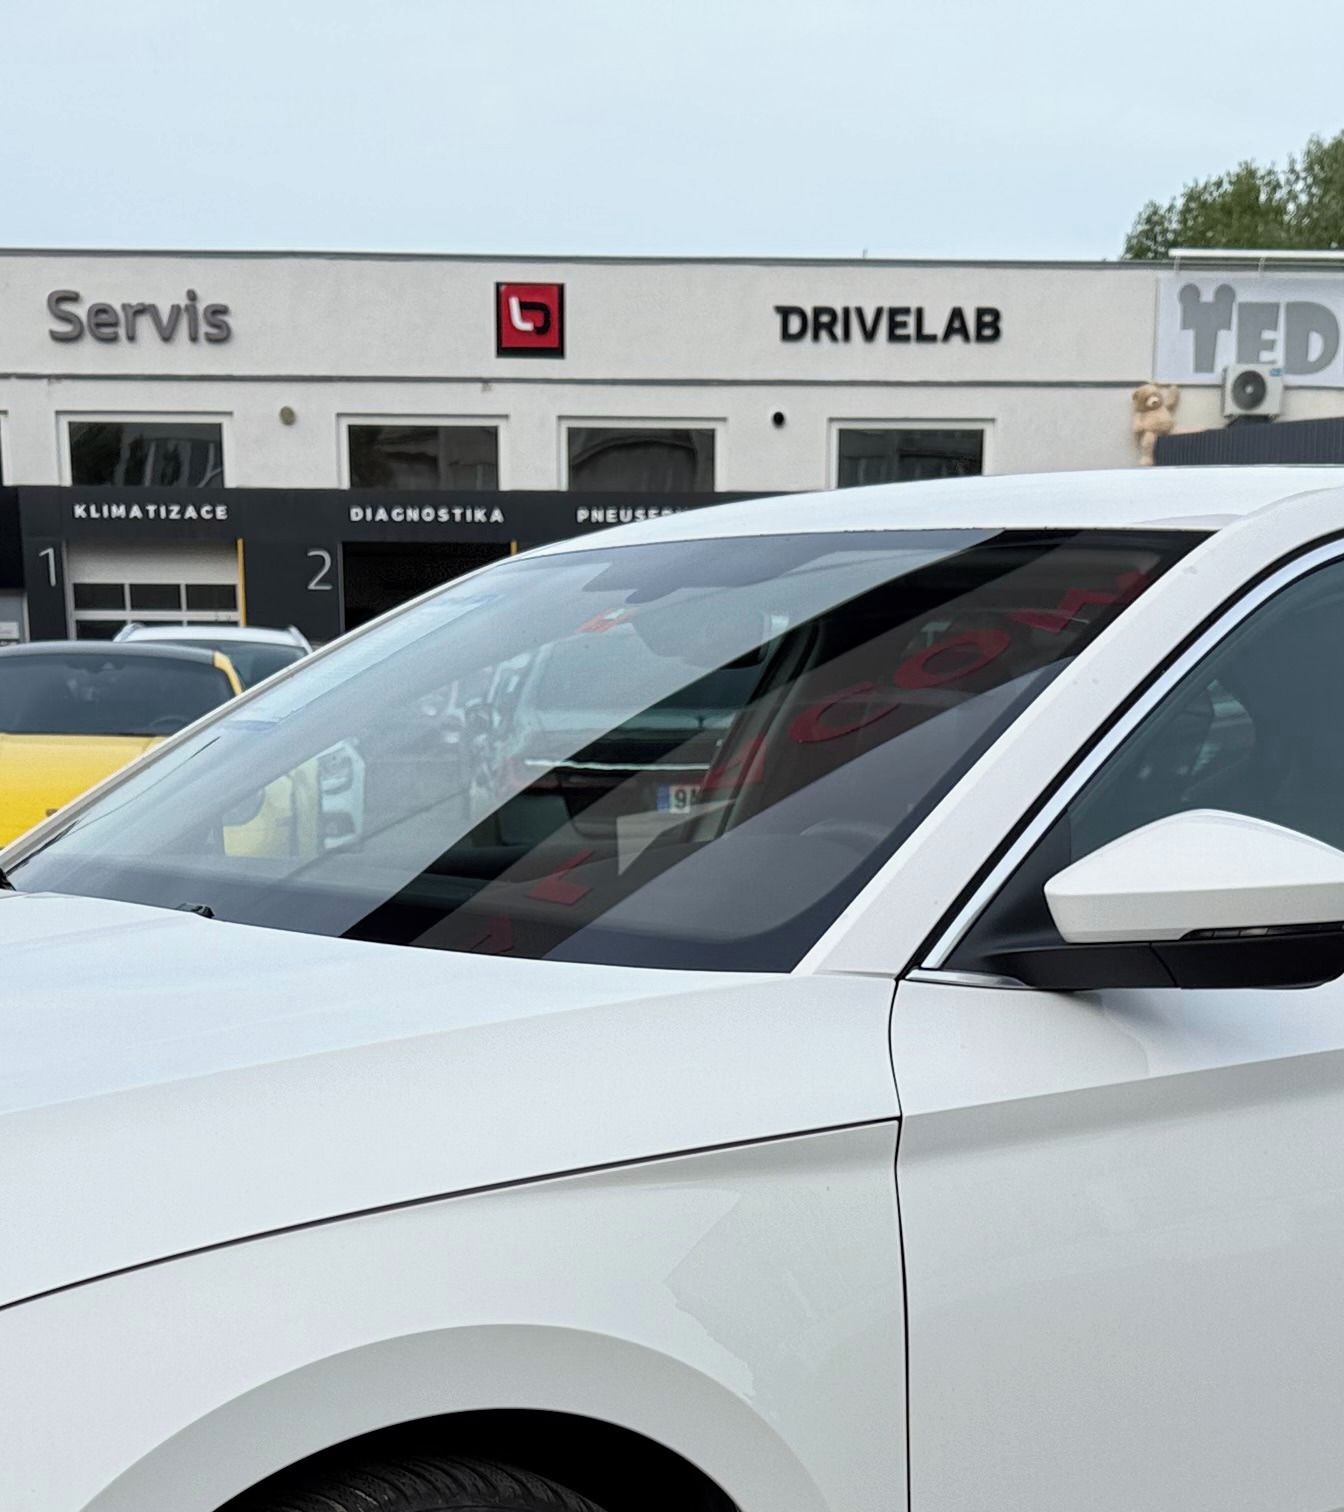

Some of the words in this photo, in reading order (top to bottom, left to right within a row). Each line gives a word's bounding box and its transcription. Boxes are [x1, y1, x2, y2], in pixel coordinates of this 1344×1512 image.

[47, 288, 233, 343] Servis
[773, 304, 1002, 344] DRIVELAB
[73, 503, 229, 521] KLIMATIZACE
[348, 505, 505, 523] DIAGNOSTIKA
[576, 504, 690, 523] PNEUSE
[38, 547, 57, 587] 1
[306, 549, 333, 590] 2
